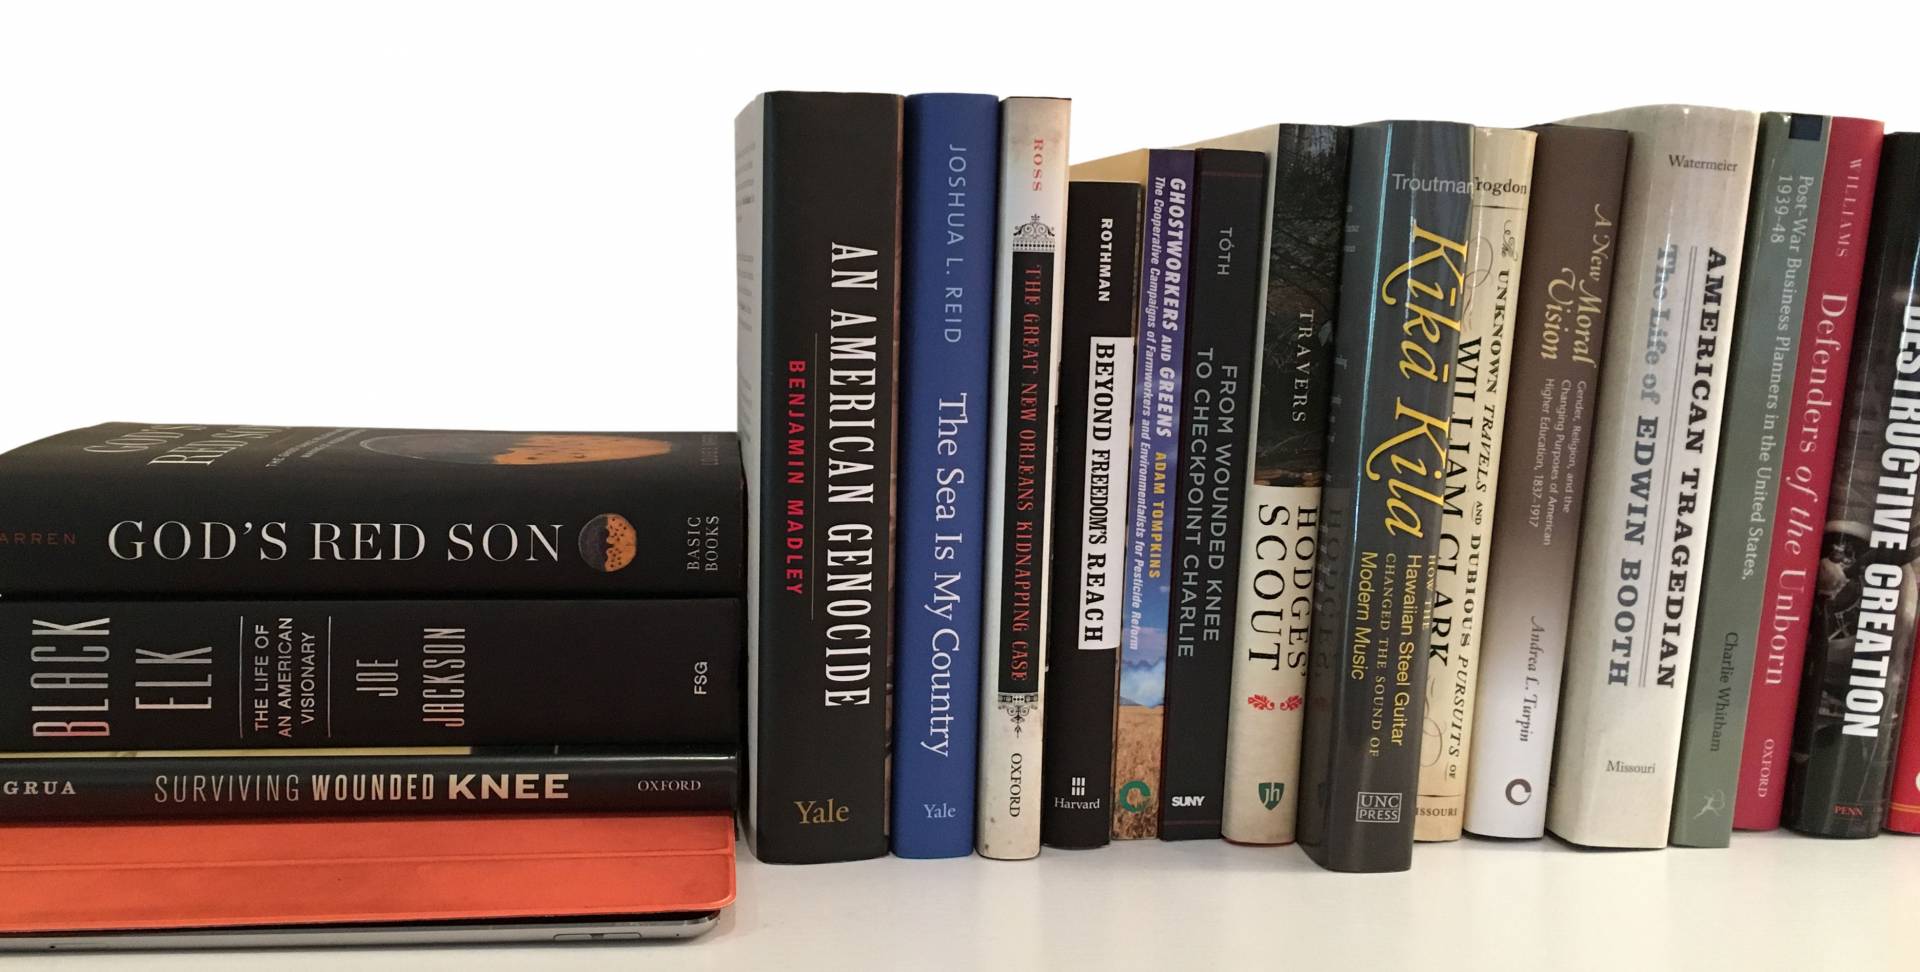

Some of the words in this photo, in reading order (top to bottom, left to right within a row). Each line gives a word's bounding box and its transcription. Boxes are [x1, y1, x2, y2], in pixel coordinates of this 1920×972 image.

[1033, 139, 1045, 191] ROSS
[1154, 176, 1165, 196] The
[1474, 177, 1527, 196] rogdon
[1669, 154, 1738, 172] Watermeier
[947, 144, 966, 245] JOSHUA
[1594, 204, 1612, 227] A
[1789, 175, 1814, 253] Post-War
[1837, 158, 1862, 257] WILLIAMS
[1150, 199, 1165, 265] Cooperative
[1162, 178, 1186, 332] GHOSTWORKERS
[1217, 227, 1235, 276] TÓTH
[1590, 234, 1611, 282] New
[831, 242, 878, 290] AN
[946, 258, 963, 275] L.
[1025, 265, 1042, 305] THE
[1098, 218, 1113, 302] ROTHMAN
[1653, 244, 1678, 301] The
[944, 287, 963, 343] REID
[1145, 267, 1160, 328] Campaigns
[1541, 267, 1576, 360] Vision
[1778, 258, 1801, 331] Business
[1022, 313, 1041, 374] GREAT
[1147, 331, 1156, 344] of
[1160, 335, 1172, 361] AND
[1487, 270, 1509, 394] UNKNOWN
[1572, 279, 1602, 368] Moral
[1685, 247, 1727, 453] AMERICAN
[1143, 345, 1156, 416] Farmworkers
[1196, 348, 1213, 379] TO
[1292, 309, 1315, 422] TRAVERS
[1641, 373, 1661, 405] of
[1767, 336, 1791, 410] Planners
[1800, 292, 1848, 453] Defenders
[828, 309, 877, 504] AMERICAN
[1020, 383, 1039, 421] NEW
[1092, 343, 1115, 441] BEYOND
[1156, 367, 1175, 437] GREENS
[1217, 365, 1237, 433] FROM
[1542, 378, 1555, 415] Higher
[1556, 379, 1572, 431] Changing
[1573, 380, 1587, 421] Gender,
[787, 360, 806, 484] BENJAMIN
[937, 393, 969, 456] The
[1141, 419, 1150, 440] and
[1475, 404, 1495, 493] TRAVELS
[1533, 417, 1551, 471] Education,
[1567, 424, 1582, 469] Religion,
[1759, 434, 1776, 462] the
[1763, 414, 1779, 431] in
[1017, 428, 1036, 511] ORLEANS
[1154, 452, 1167, 495] ADAM
[1183, 388, 1211, 545] CHECKPOINT
[1365, 396, 1450, 538] Kila
[1552, 434, 1566, 483] Purposes
[1564, 473, 1574, 494] and
[1624, 415, 1659, 545] EDWIN
[1785, 466, 1818, 503] of
[935, 468, 965, 522] Sea
[1089, 449, 1110, 545] FREEDOM'S
[1136, 442, 1151, 538] Environmentalists
[1208, 444, 1232, 570] WOUNDED
[1474, 501, 1483, 526] AND
[1550, 484, 1559, 494] of
[1562, 495, 1572, 513] the
[1751, 467, 1772, 522] United
[107, 520, 288, 561] GOD'S
[309, 522, 426, 561] RED
[448, 522, 565, 562] SON
[687, 516, 701, 570] BASIC
[705, 515, 719, 572] BOOKS
[785, 500, 804, 594] MADLEY
[934, 533, 962, 561] Is
[1149, 500, 1165, 578] TOMPKINS
[1544, 495, 1558, 546] American
[1785, 507, 1813, 556] the
[1135, 541, 1145, 556] for
[1741, 528, 1764, 580] States.
[924, 572, 961, 621] My
[1012, 521, 1033, 632] KIDNAPPING
[1084, 553, 1106, 642] REACH
[1132, 558, 1144, 609] Pesticide
[1248, 504, 1290, 671] SCOUT
[1287, 505, 1318, 677] HODGES'
[1356, 551, 1378, 620] Modern
[1381, 553, 1397, 631] CHANGED
[1401, 555, 1422, 636] Hawaiian
[1460, 534, 1481, 648] DUBIOUS
[1656, 468, 1700, 688] TRAGEDIAN
[825, 523, 873, 707] GENOCIDE
[1129, 610, 1141, 650] Reform
[1177, 554, 1200, 658] CHARLIE
[1203, 579, 1223, 642] KNEE
[1608, 558, 1642, 687] BOOTH
[1765, 568, 1806, 686] Unborn
[255, 624, 269, 650] OF
[278, 616, 294, 710] AMERICAN
[1011, 640, 1029, 681] CASE
[1352, 626, 1372, 680] Music
[1377, 637, 1389, 669] THE
[1396, 641, 1415, 686] Steel
[1527, 616, 1545, 671] Andrea
[1720, 631, 1738, 683] Charlie
[1842, 563, 1903, 737] CREATION
[30, 617, 110, 737] BLACK
[135, 646, 212, 710] ELK
[255, 655, 269, 695] LIFE
[301, 631, 316, 724] VISIONARY
[355, 659, 399, 697] JOE
[422, 628, 466, 727] JACKSON
[694, 661, 708, 694] FSG
[920, 629, 959, 757] Country
[255, 698, 269, 732] THE
[278, 713, 293, 738] AN
[1371, 675, 1386, 730] SOUND
[1391, 692, 1410, 746] Guitar
[1449, 655, 1469, 758] PURSUITS
[1515, 694, 1538, 743] Turpin
[1710, 687, 1732, 752] Whitham
[1369, 737, 1381, 758] OF
[1605, 760, 1656, 774] Missouri
[1758, 738, 1775, 798] OXFORD
[3, 781, 77, 795] GRUA
[155, 774, 299, 803] SURVIVING
[312, 773, 434, 801] WOUNDED
[449, 774, 569, 800] KNEE
[637, 780, 702, 792] OXFORD
[794, 799, 849, 824] Yale
[923, 804, 957, 818] Yale
[1009, 752, 1023, 818] OXFORD
[1054, 797, 1100, 810] Harvard
[1172, 796, 1205, 807] SUNY
[1361, 795, 1399, 808] UNC
[1833, 805, 1864, 816] PENN
[1359, 810, 1398, 821] PRESS
[1415, 808, 1457, 817] ISSOURI
